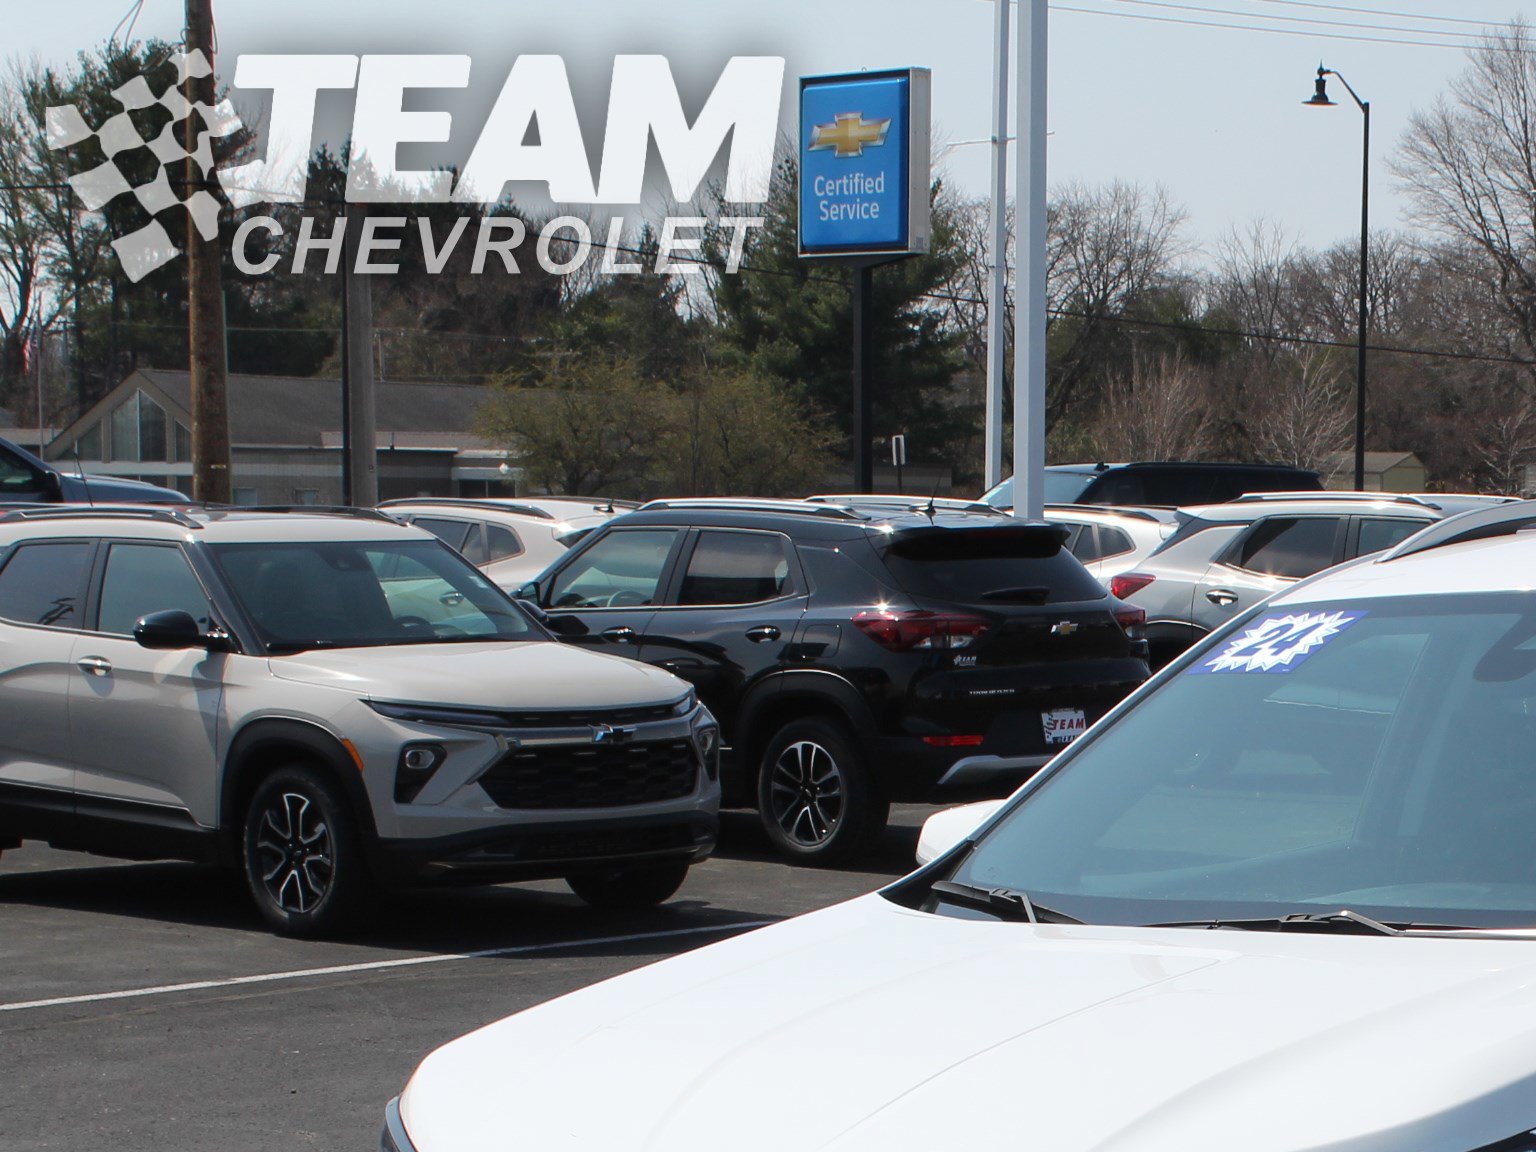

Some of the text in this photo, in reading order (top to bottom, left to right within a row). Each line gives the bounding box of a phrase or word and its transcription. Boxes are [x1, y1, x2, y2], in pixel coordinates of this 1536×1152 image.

[814, 171, 885, 197] Certified
[819, 198, 880, 221] Service
[1230, 622, 1325, 658] 24
[1052, 718, 1085, 730] TEAM
